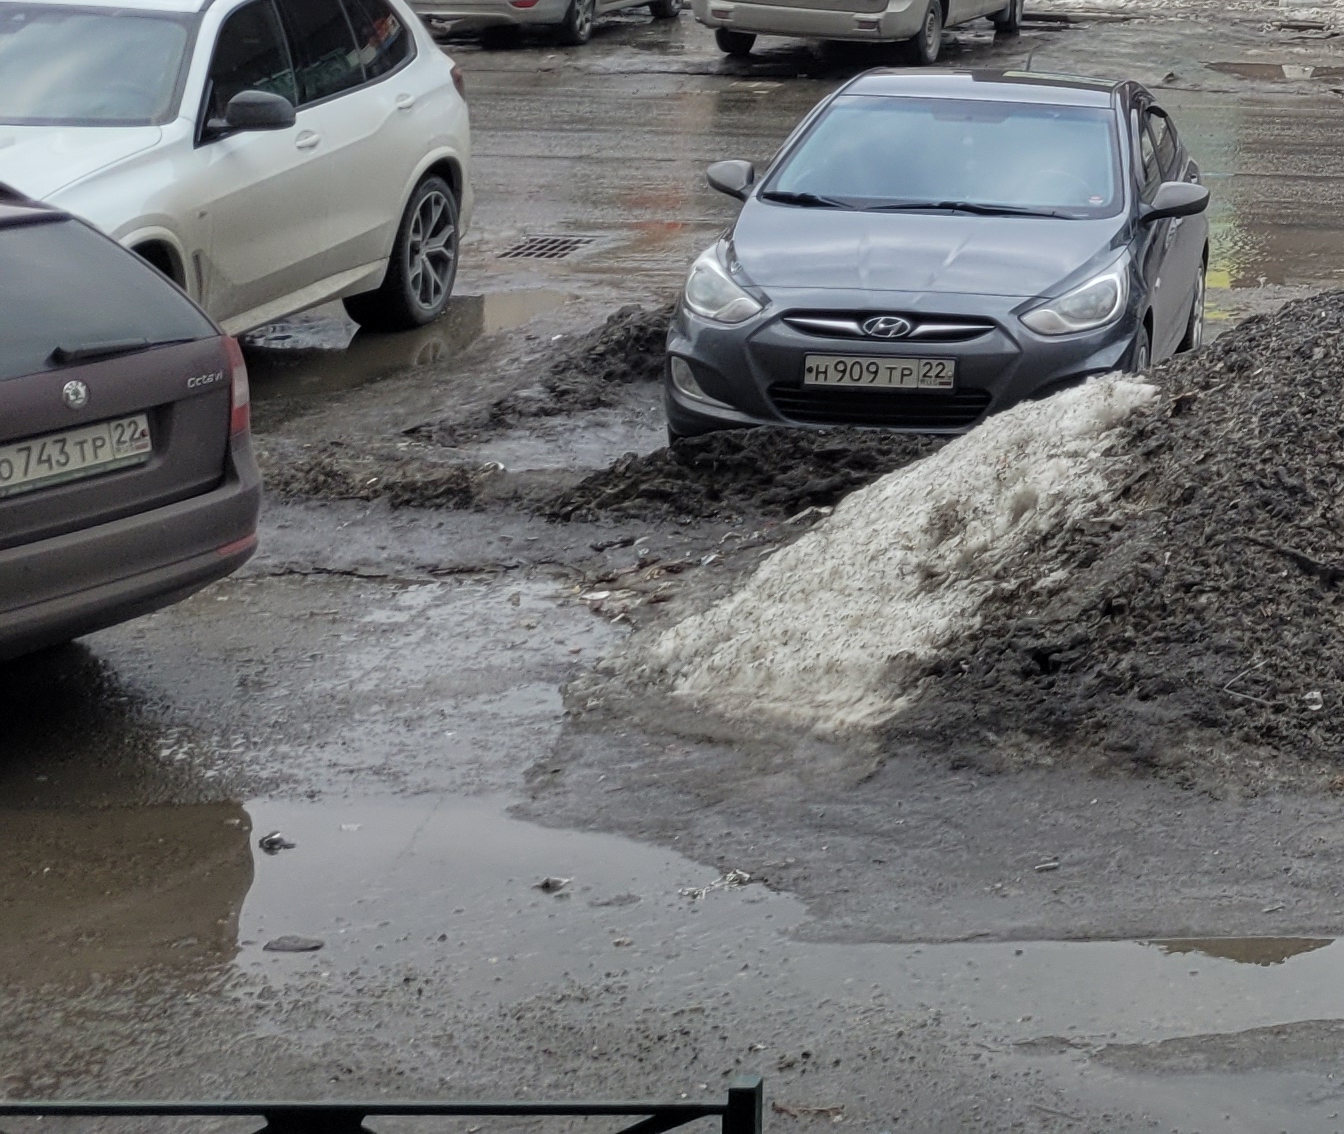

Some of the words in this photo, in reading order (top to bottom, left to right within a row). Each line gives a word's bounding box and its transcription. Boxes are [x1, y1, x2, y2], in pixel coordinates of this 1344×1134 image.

[814, 359, 913, 385] Н909ТР
[922, 361, 946, 379] 22
[114, 419, 141, 446] 22
